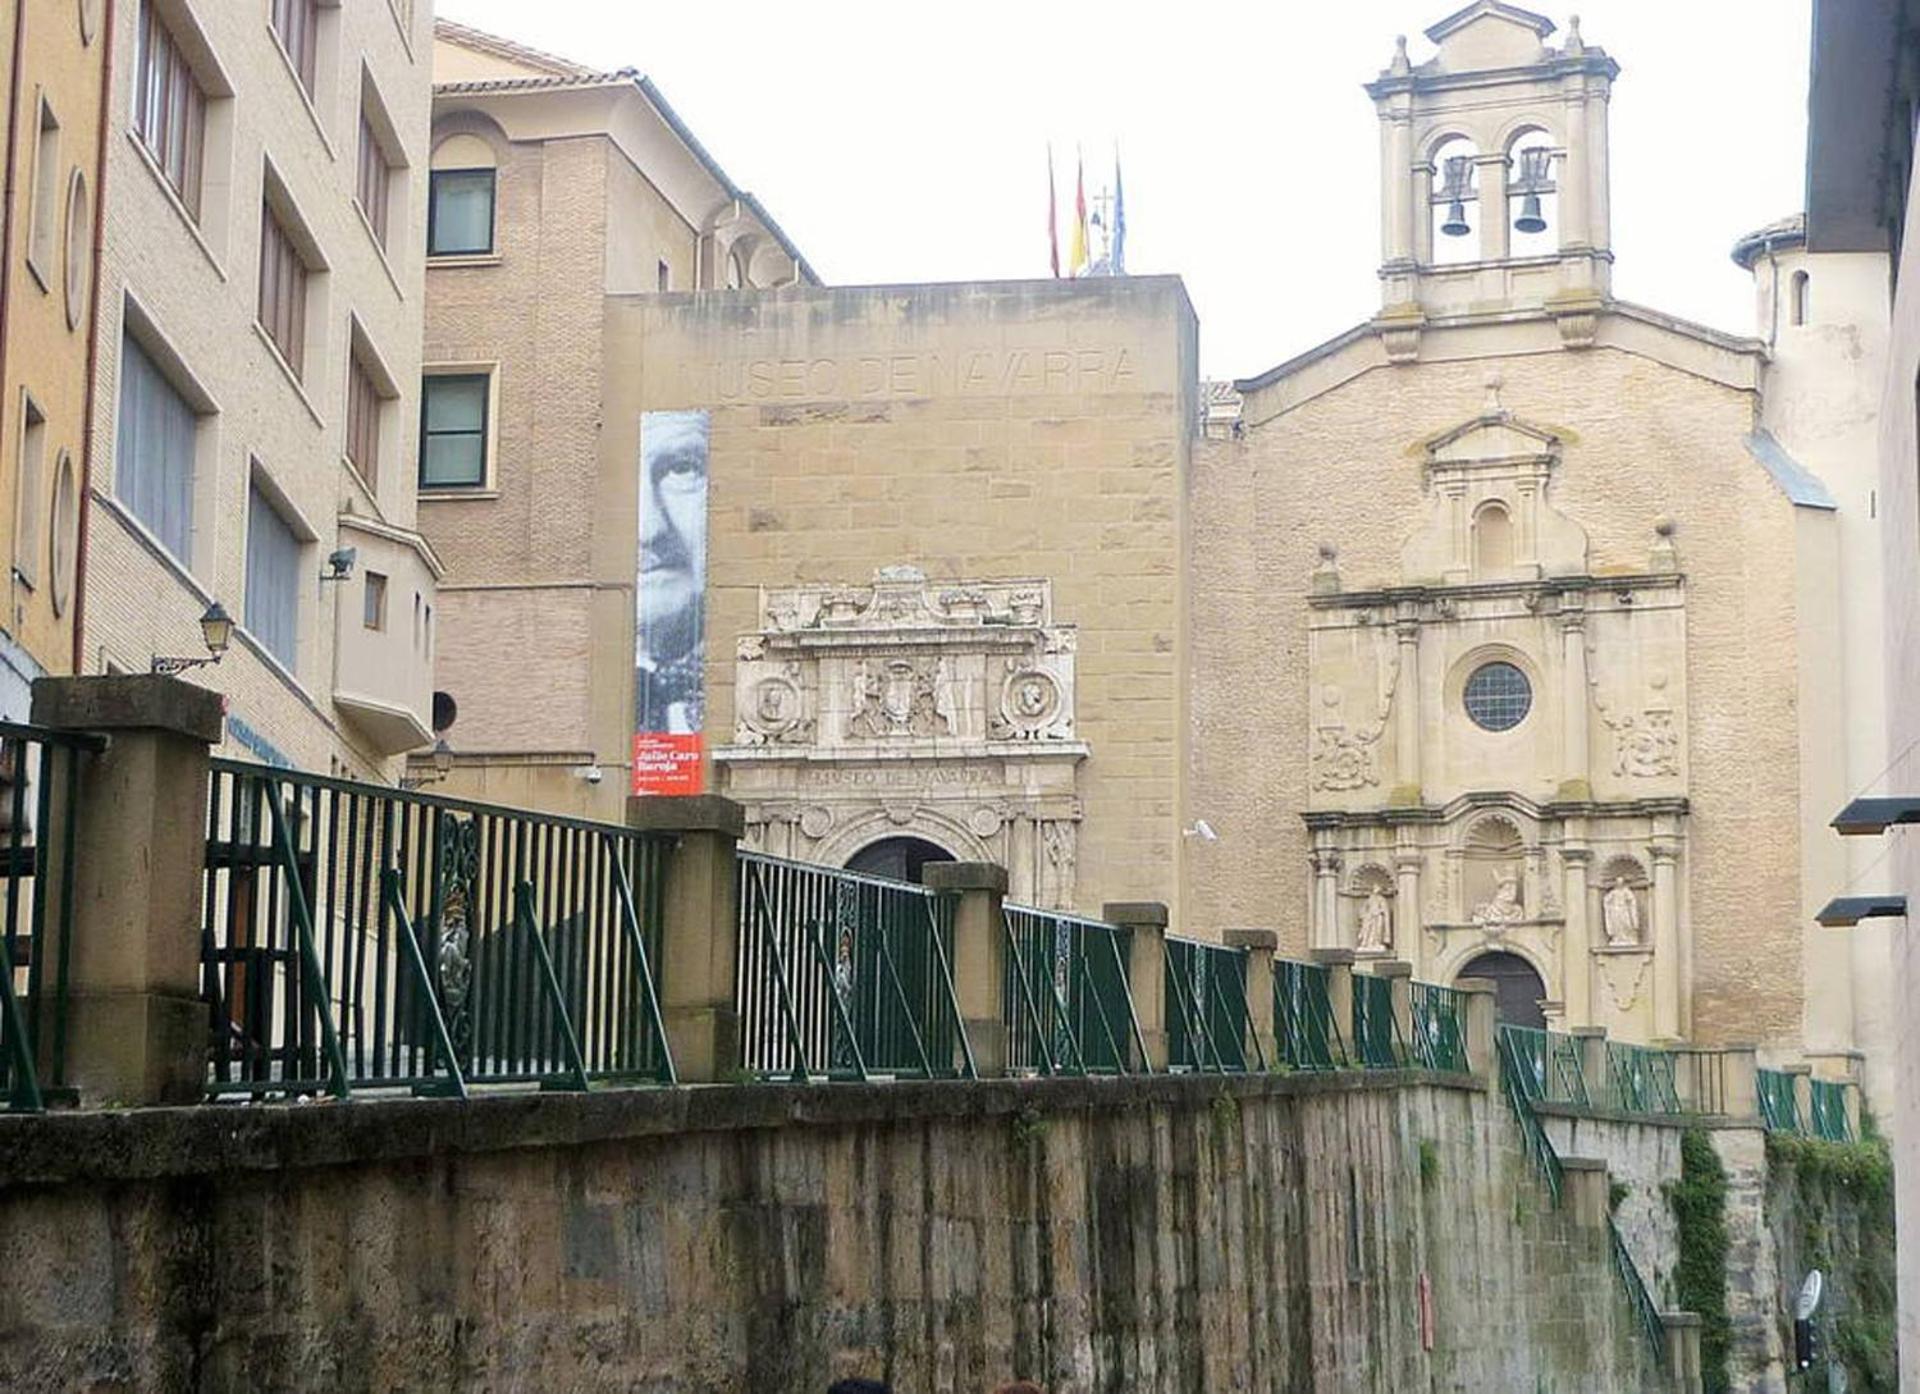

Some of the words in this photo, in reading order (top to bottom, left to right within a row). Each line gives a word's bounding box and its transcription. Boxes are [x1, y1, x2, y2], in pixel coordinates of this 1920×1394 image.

[857, 352, 918, 396] DE
[929, 345, 1138, 393] NAVARRA
[670, 751, 699, 761] Caro
[638, 761, 678, 772] Baroja
